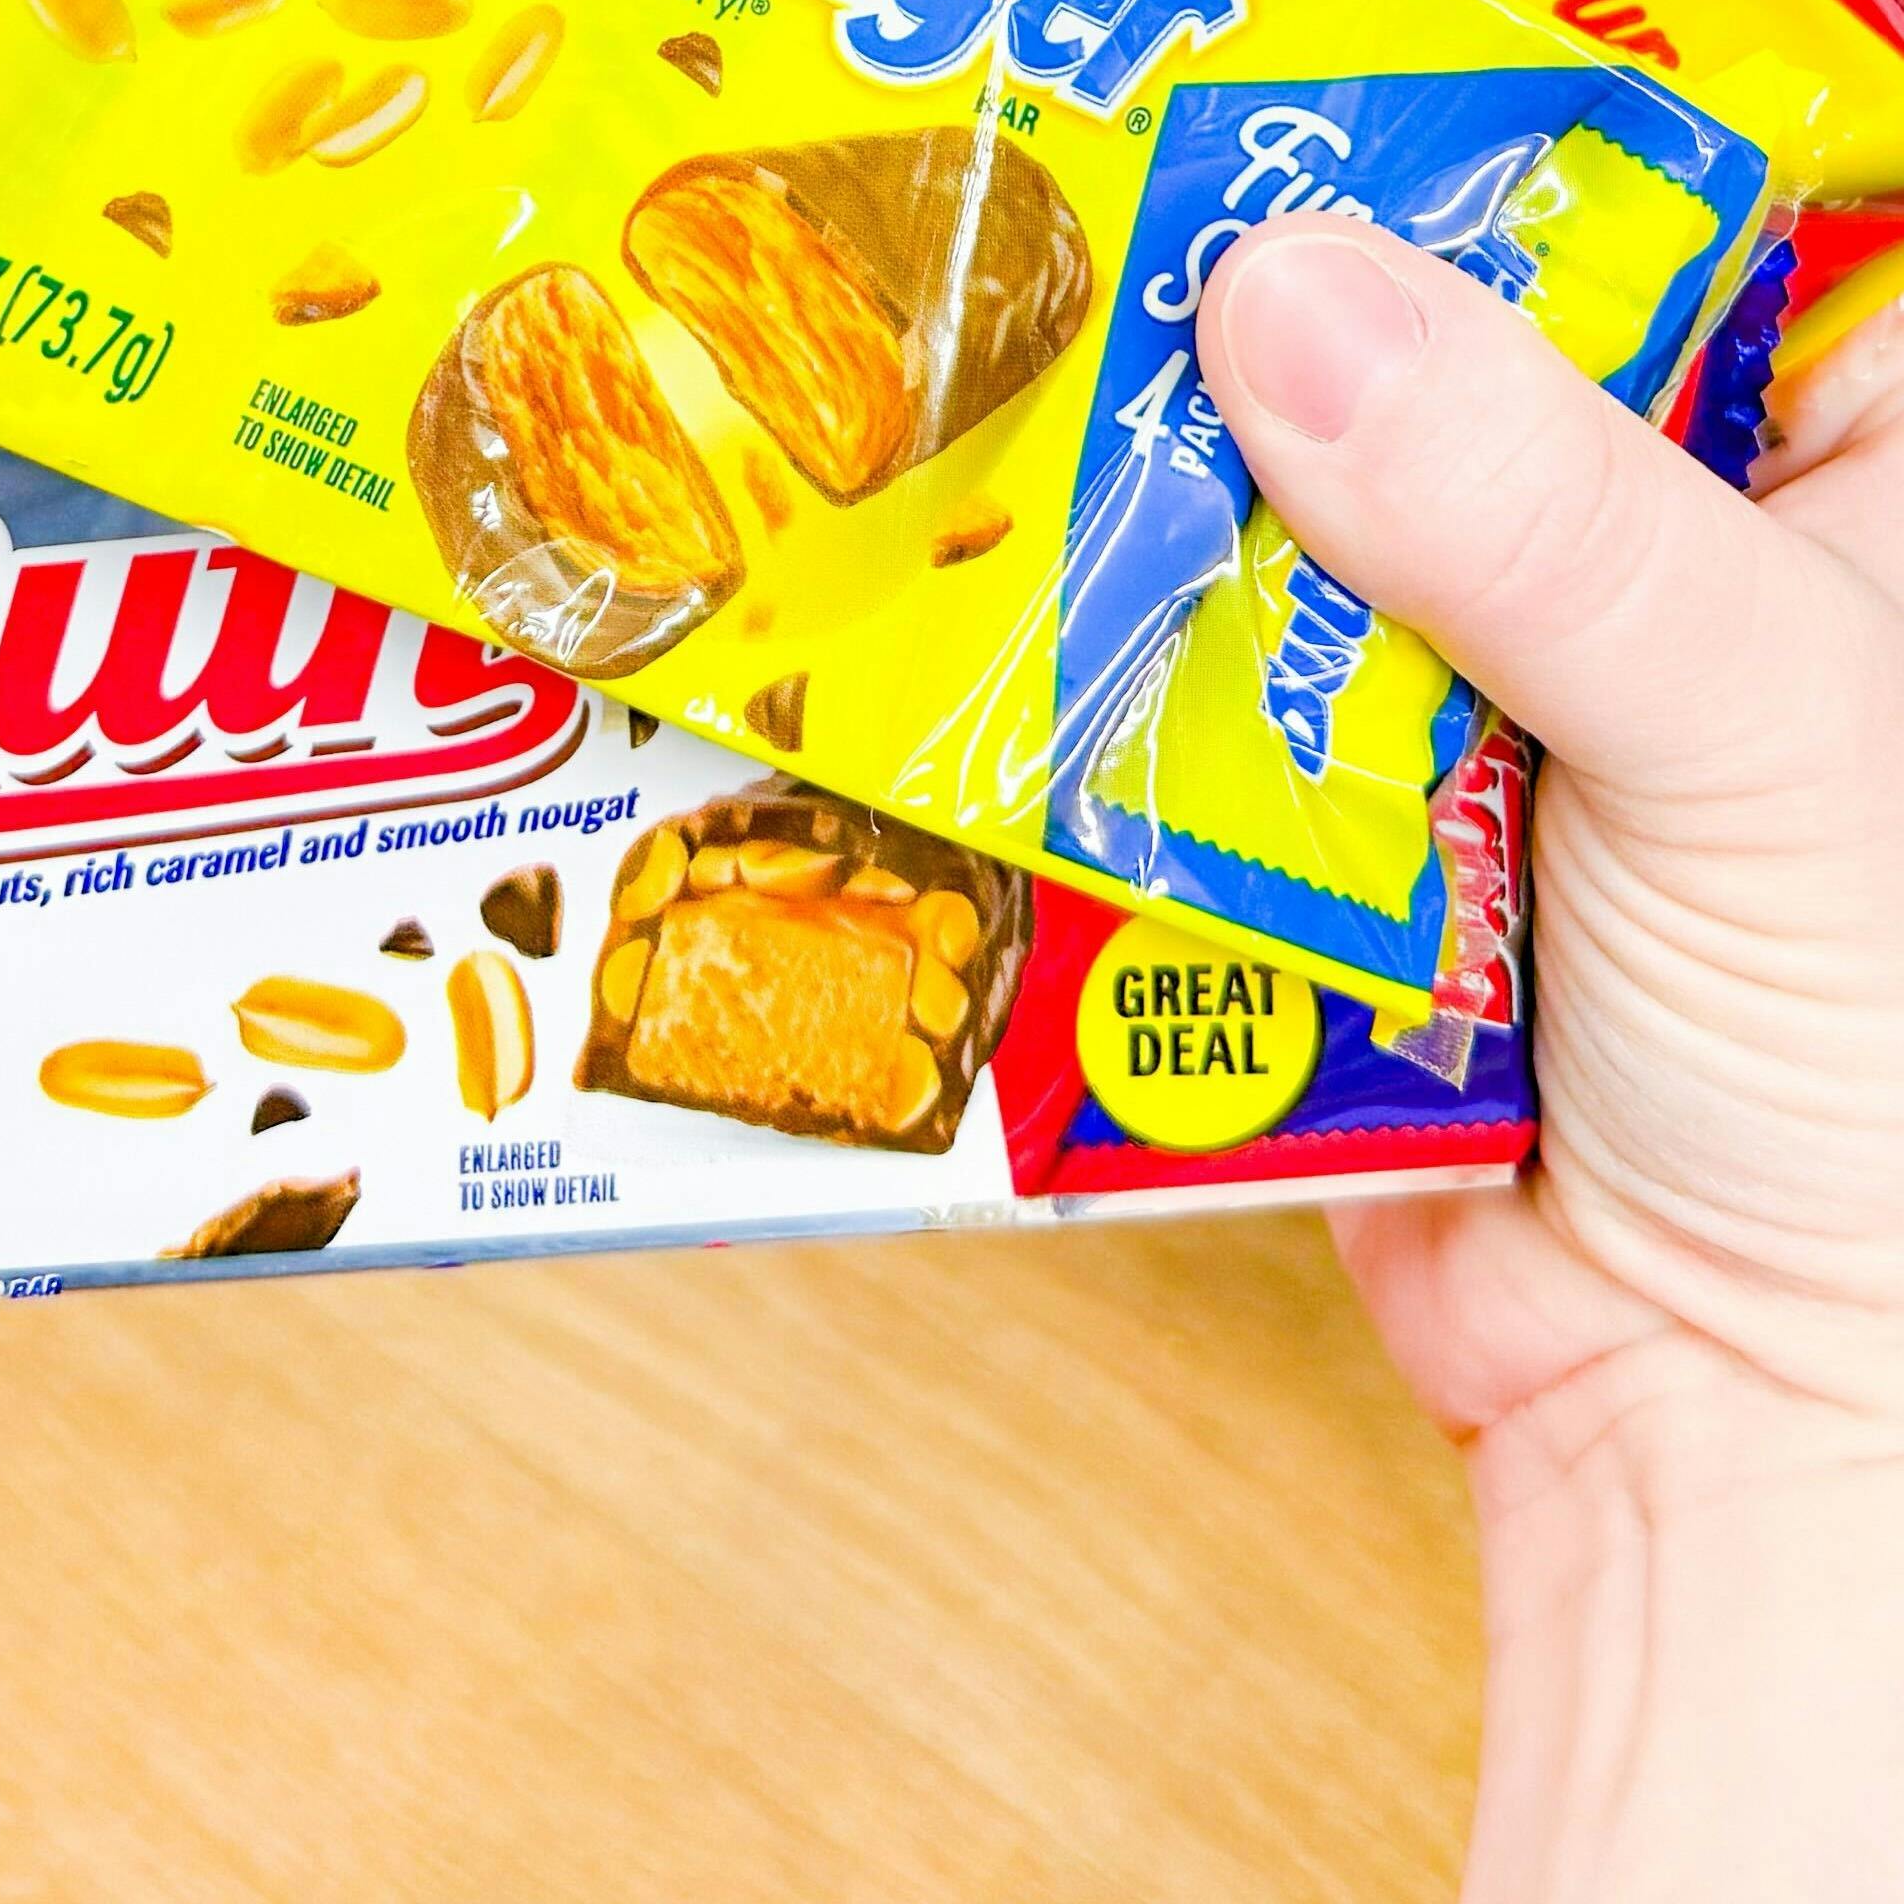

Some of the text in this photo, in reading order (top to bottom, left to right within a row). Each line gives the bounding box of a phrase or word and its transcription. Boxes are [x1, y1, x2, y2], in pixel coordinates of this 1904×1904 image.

[249, 378, 359, 449] ENLARGED
[1115, 349, 1190, 458] 4
[1168, 381, 1223, 479] PAC
[234, 414, 398, 513] TO SHOW DETAIL
[63, 845, 134, 897] rich
[145, 829, 292, 886] caramel
[299, 820, 368, 868] and
[376, 804, 508, 858] smooth
[517, 786, 641, 845] nougat
[1113, 962, 1280, 1020] GREAT
[1127, 1022, 1270, 1078] DEAL
[459, 1140, 562, 1175] ENLARGED
[459, 1173, 620, 1211] TO SHOW DETAIL
